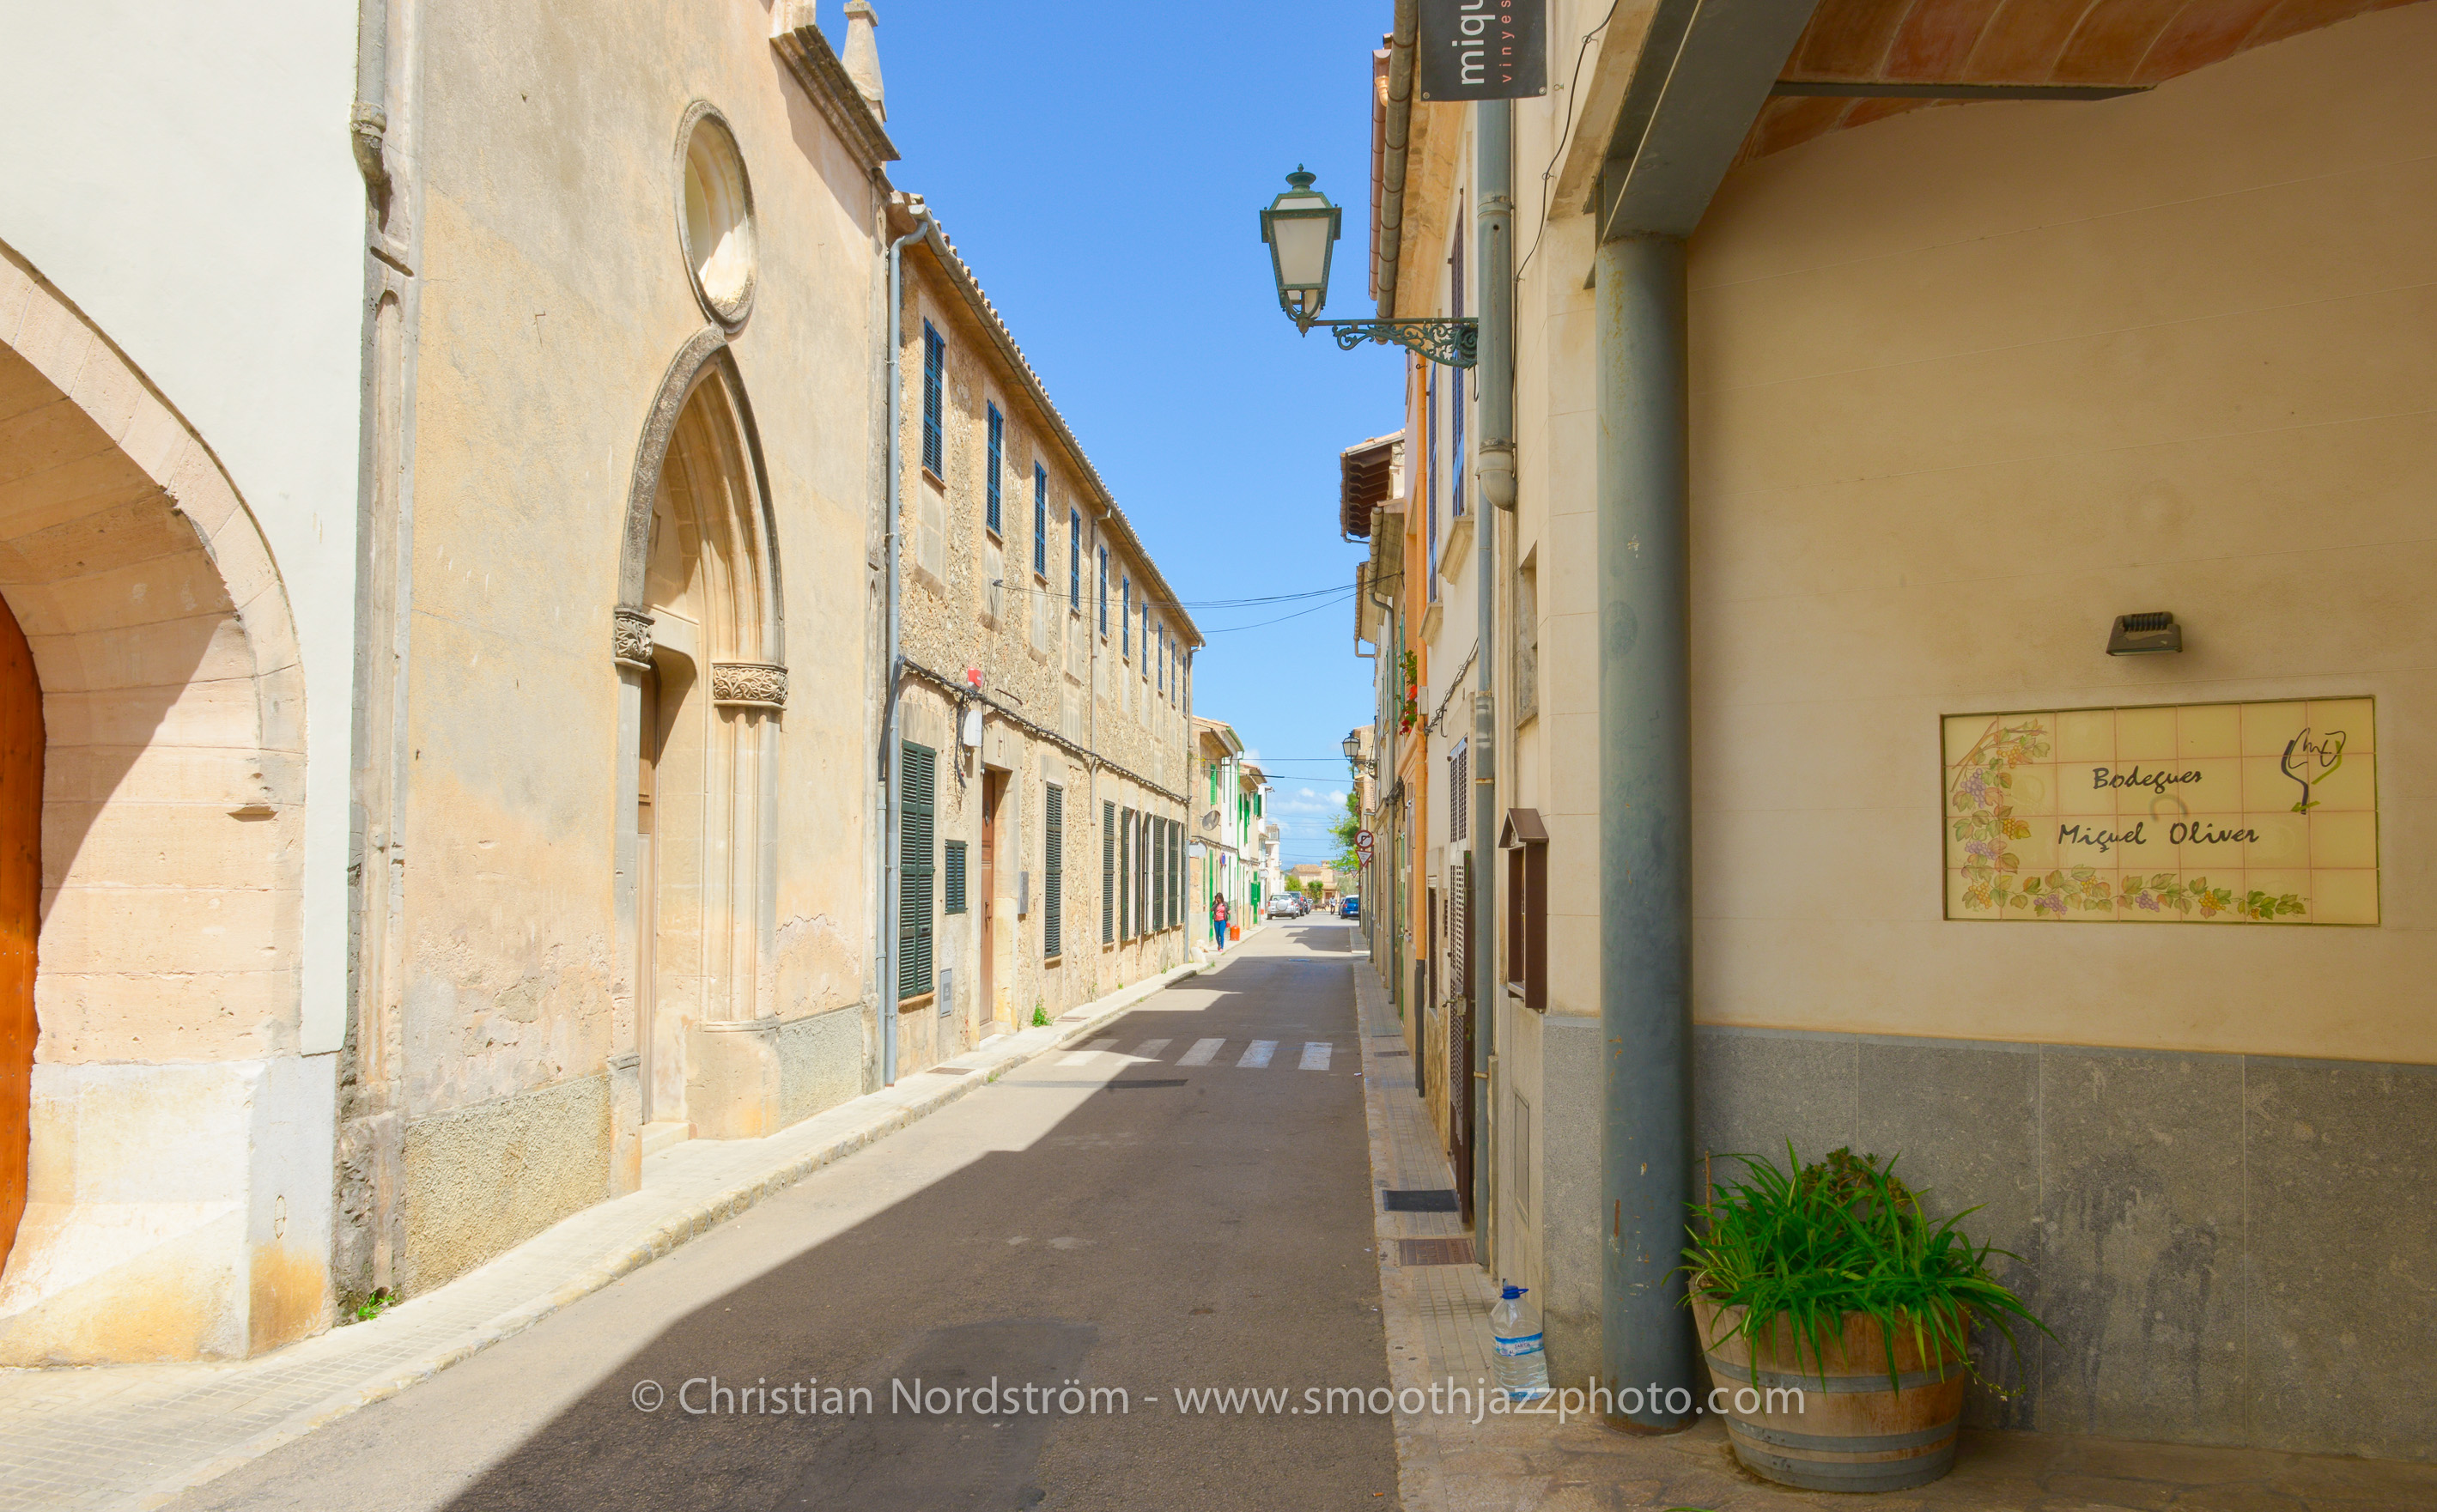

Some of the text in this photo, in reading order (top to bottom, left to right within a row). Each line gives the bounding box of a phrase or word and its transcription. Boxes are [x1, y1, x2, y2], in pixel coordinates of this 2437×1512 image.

[1499, 0, 1515, 83] vinyes
[2092, 765, 2203, 794] Bodegues
[2169, 821, 2259, 845] Oliver
